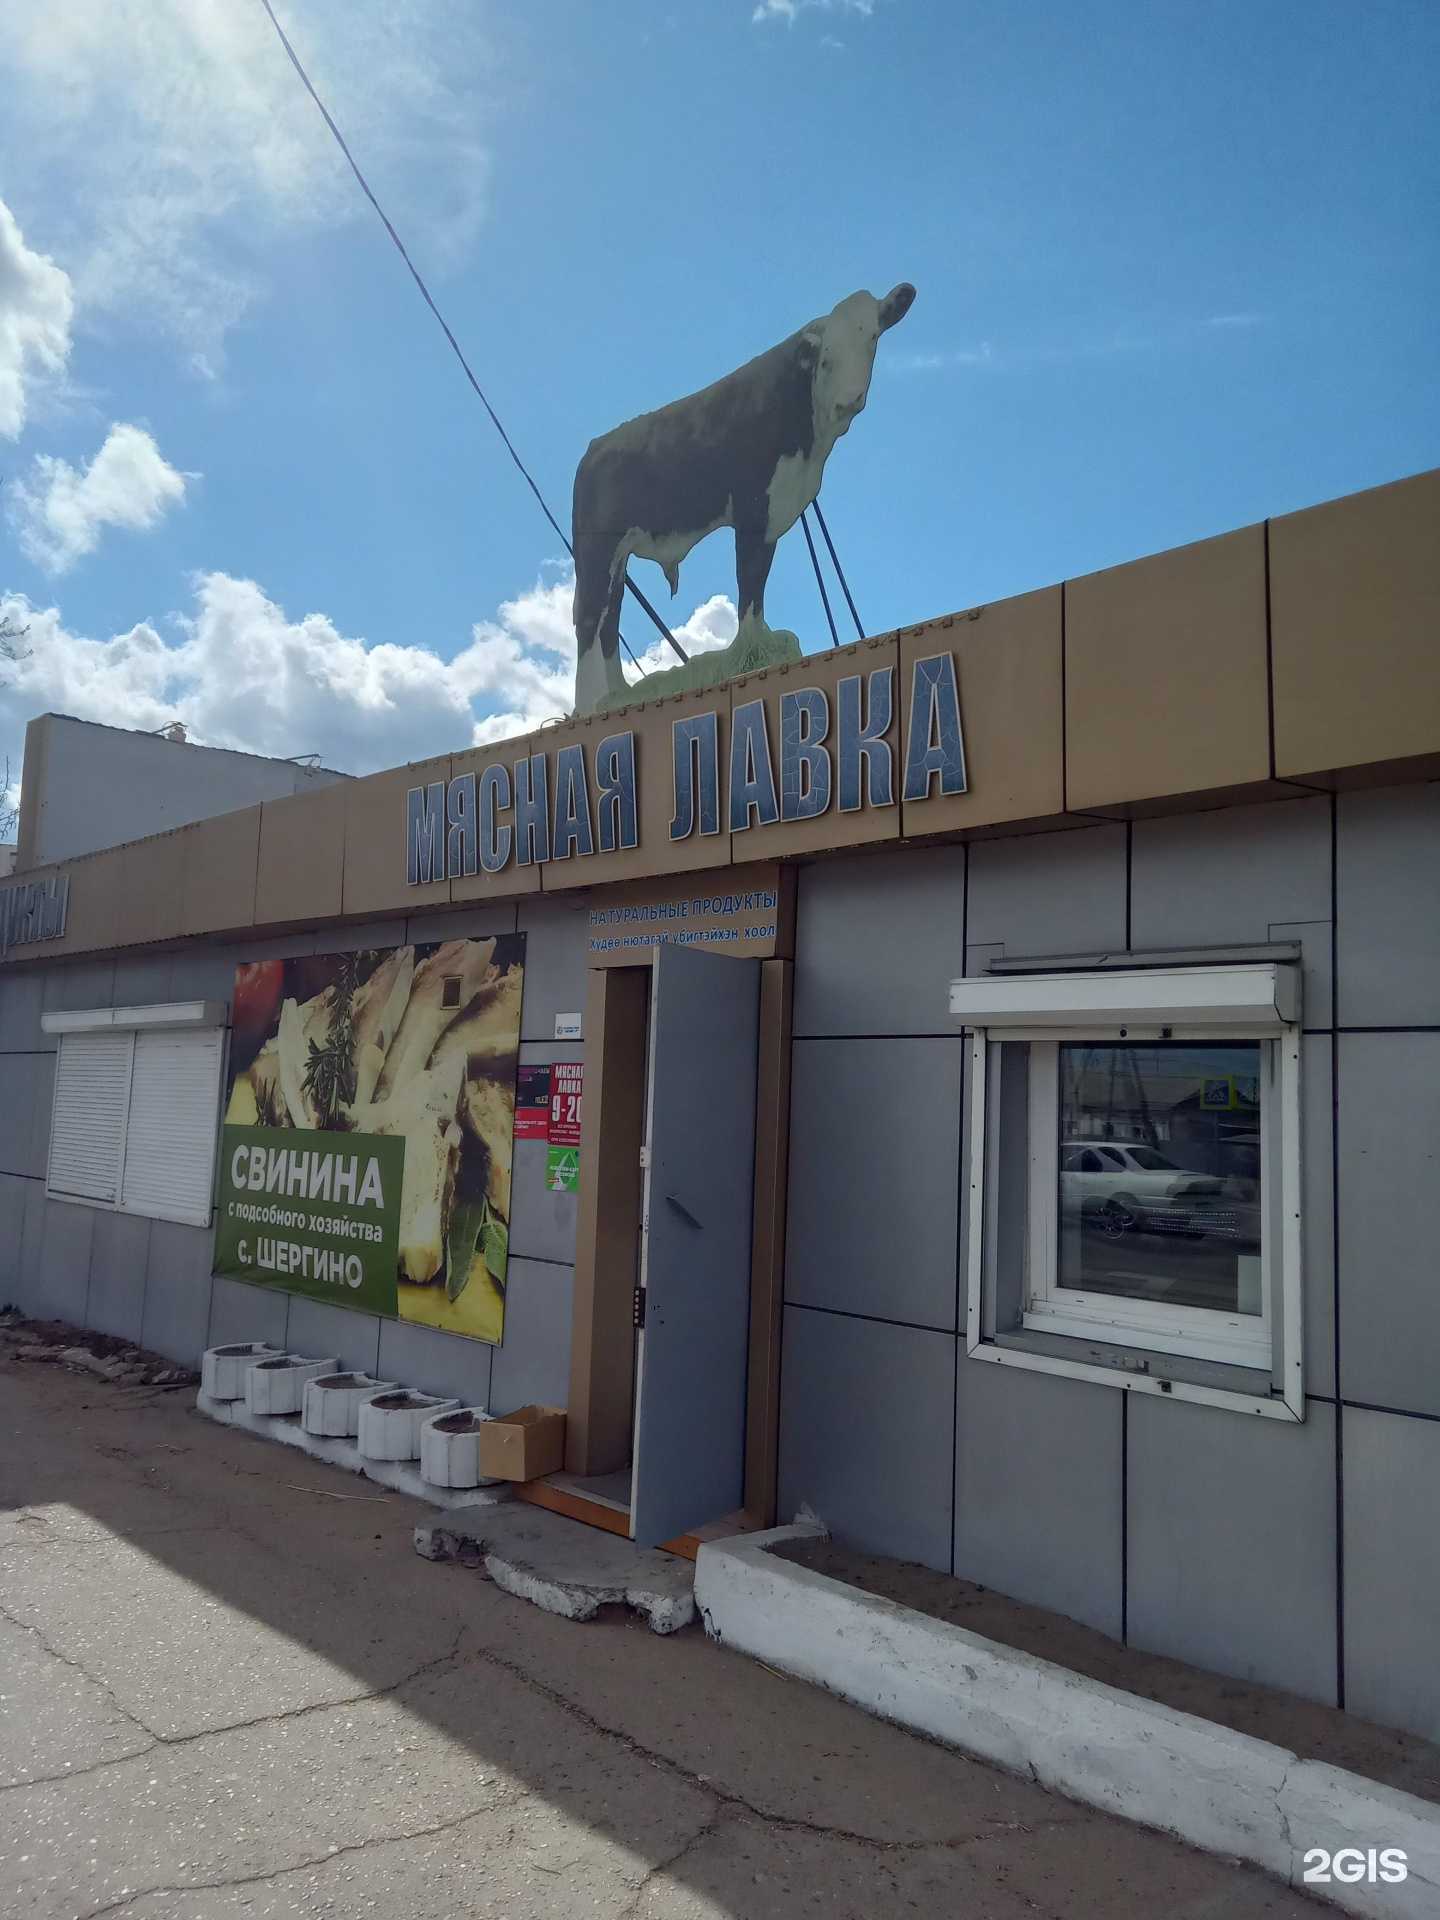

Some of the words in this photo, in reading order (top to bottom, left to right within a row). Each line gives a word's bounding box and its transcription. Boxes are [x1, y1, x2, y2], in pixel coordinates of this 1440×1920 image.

[406, 730, 638, 886] МЯСНАЯ
[668, 650, 968, 842] ЛАВКА
[589, 900, 689, 927] НАТУРАЛЬНЫЕ
[692, 890, 777, 917] ПРОДУКТЫ
[743, 924, 776, 939] хоол
[231, 1144, 385, 1209] СВИНИНА
[228, 1202, 234, 1217] с
[235, 1203, 306, 1230] подсобного
[308, 1214, 384, 1243] хозяйства
[256, 1236, 363, 1289] ШЕРГИНО
